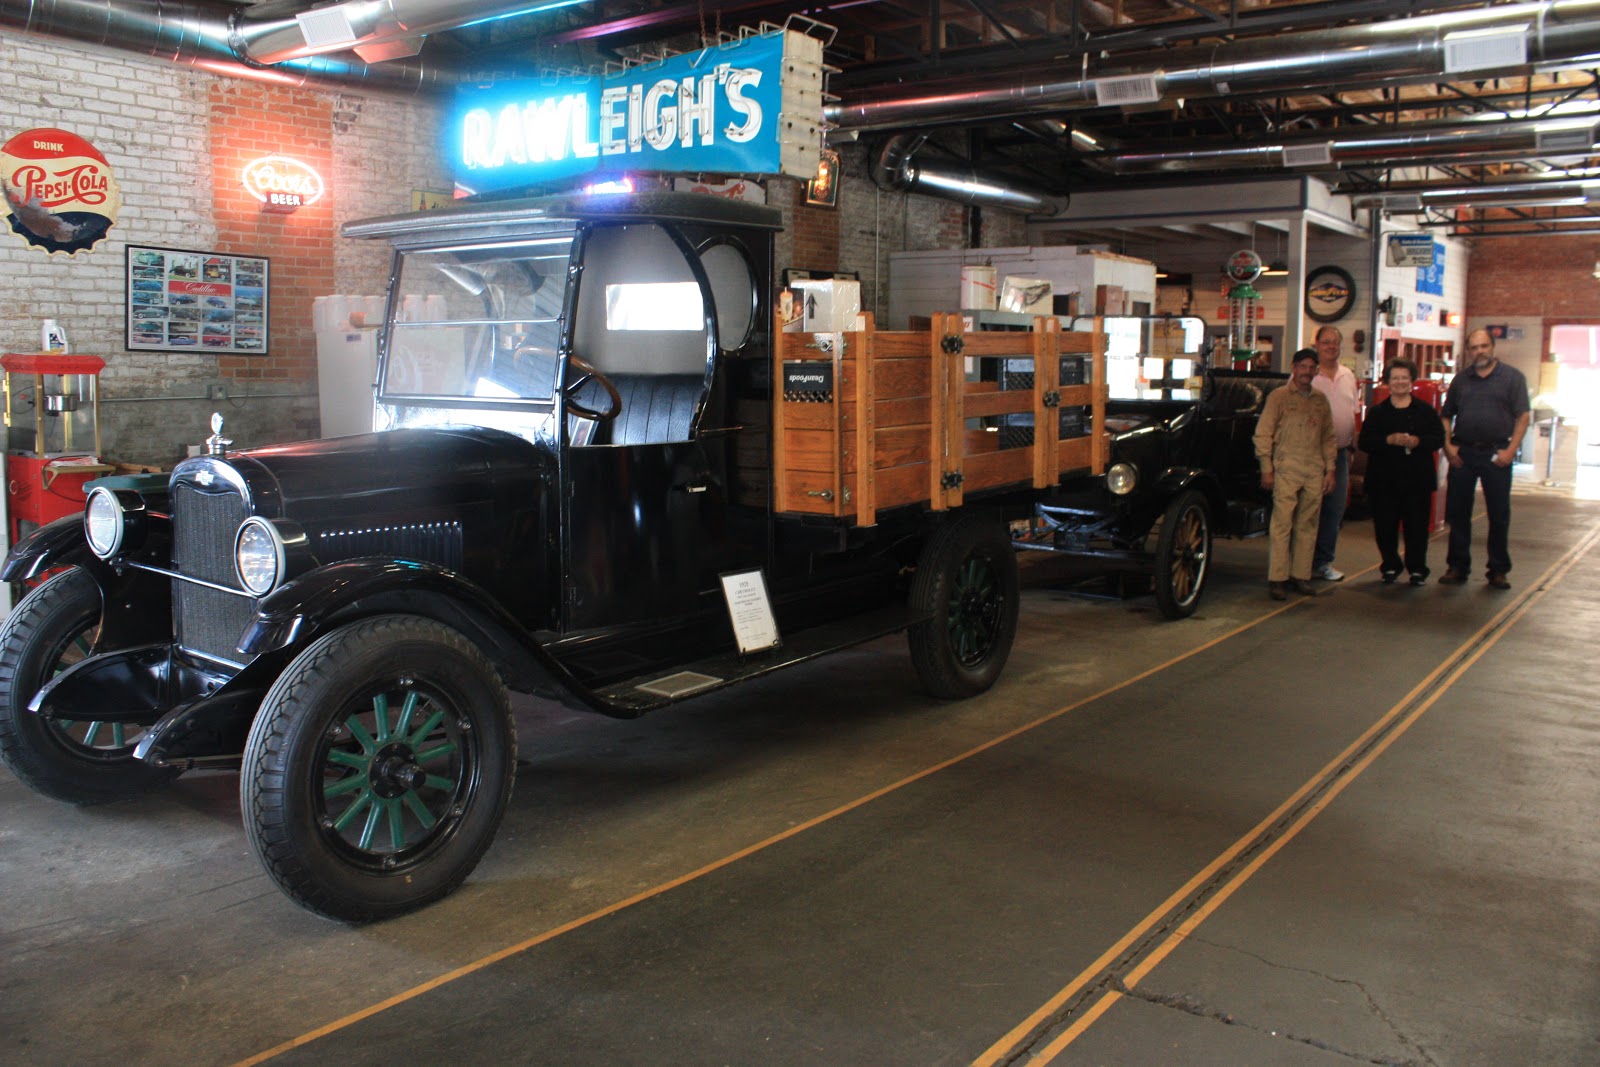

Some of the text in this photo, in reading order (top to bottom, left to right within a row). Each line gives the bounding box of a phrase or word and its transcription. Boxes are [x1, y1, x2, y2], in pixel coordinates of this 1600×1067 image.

[463, 63, 763, 170] RAWLEIGH'S
[33, 140, 64, 152] DRINK
[270, 193, 301, 206] BEER
[184, 281, 217, 293] Cadillac
